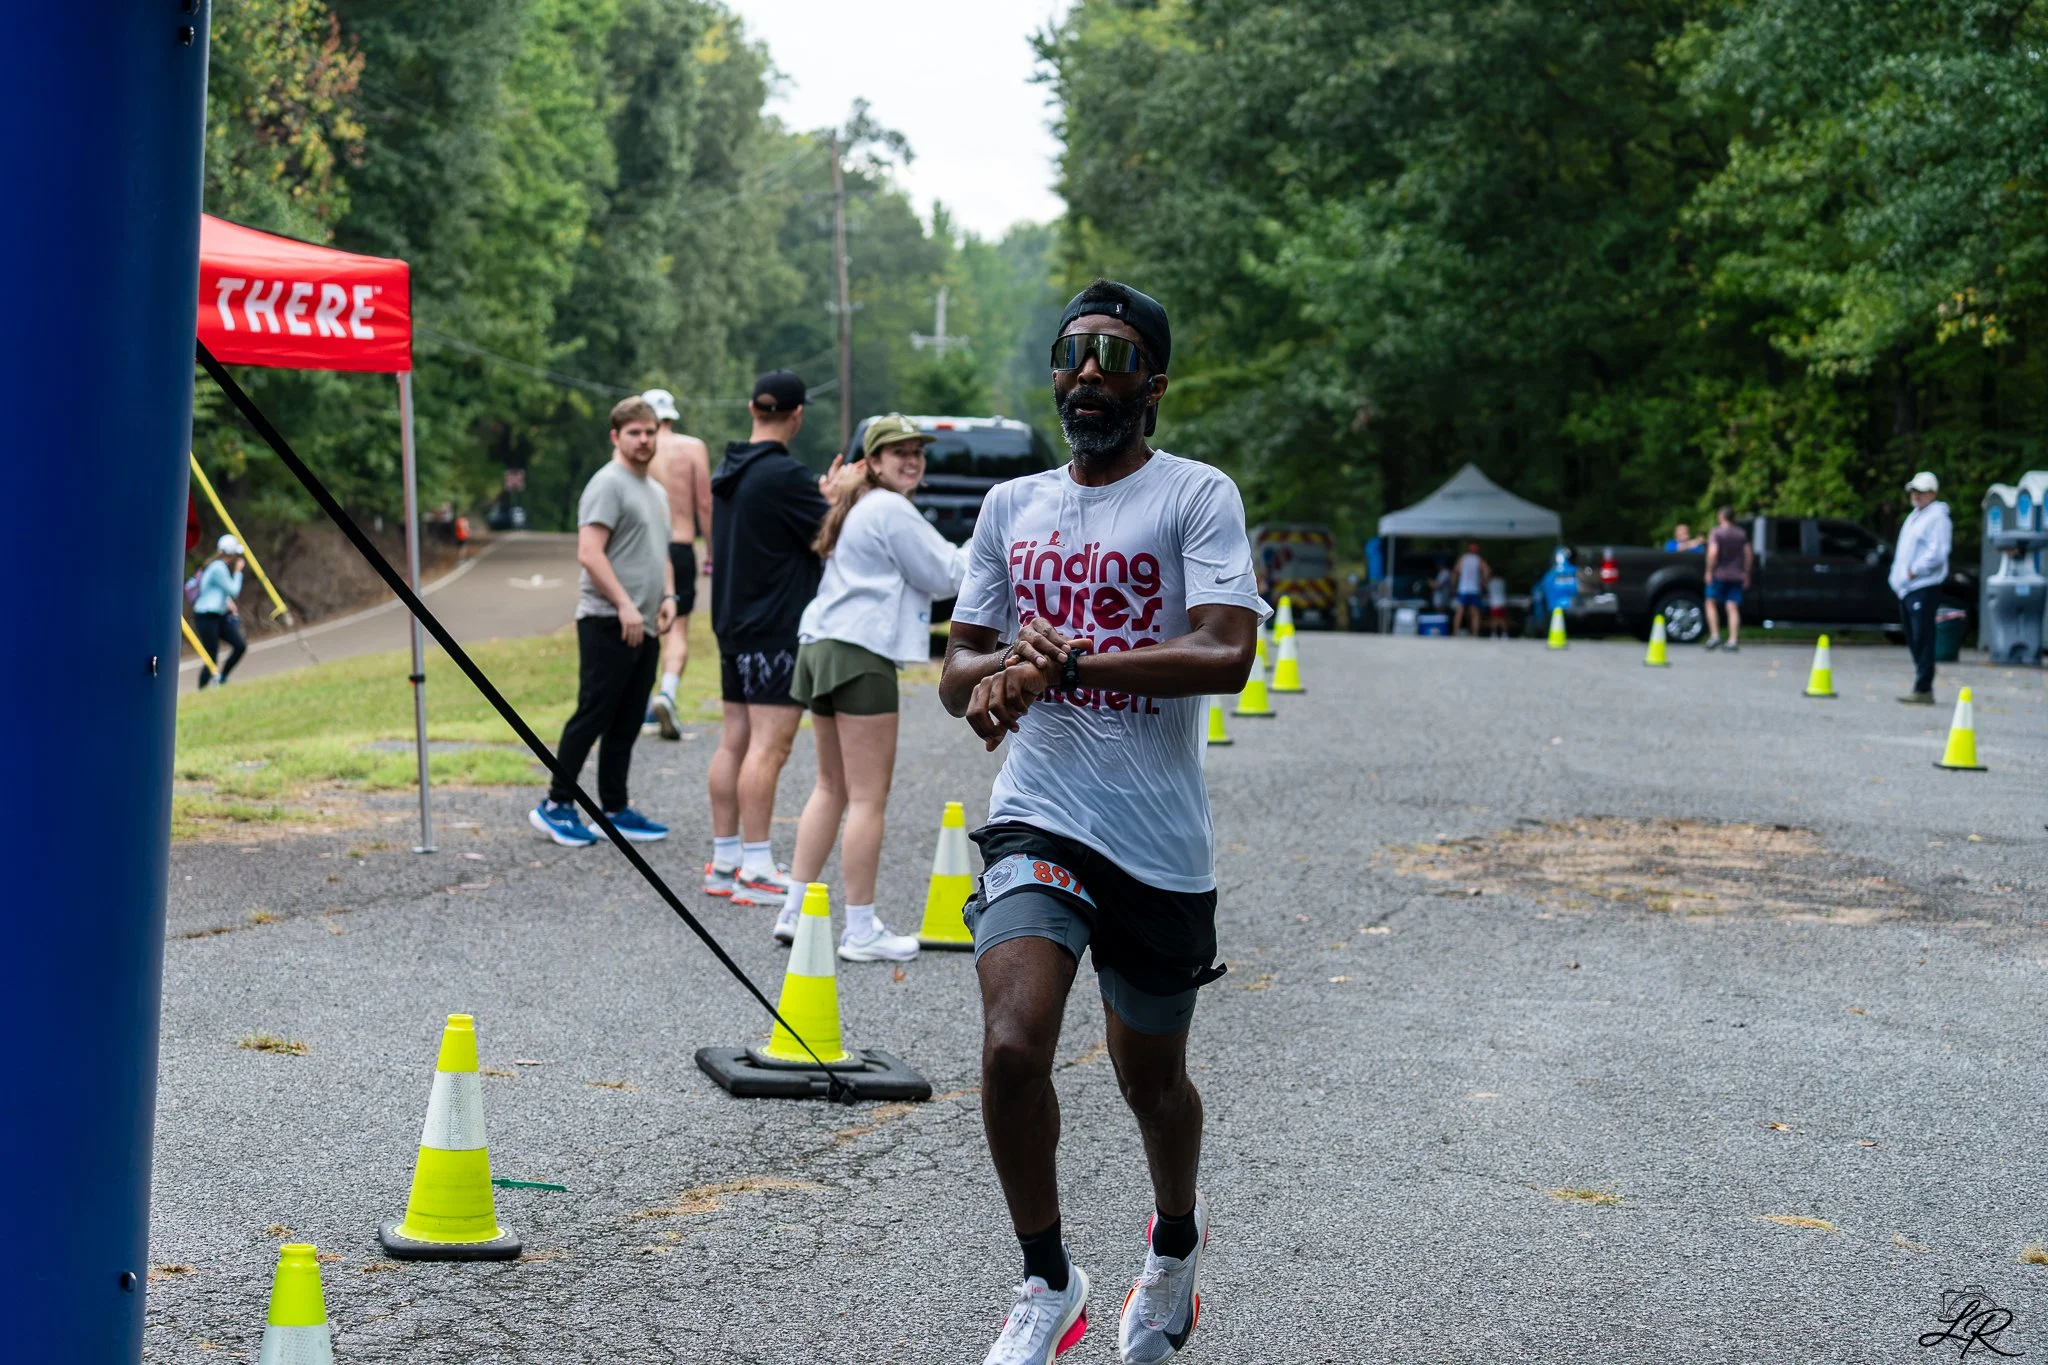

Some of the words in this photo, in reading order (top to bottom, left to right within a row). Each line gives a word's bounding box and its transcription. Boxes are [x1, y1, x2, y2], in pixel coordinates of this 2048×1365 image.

[1008, 541, 1160, 597] Finding
[1014, 583, 1163, 632] cures.
[1032, 860, 1083, 894] 897
